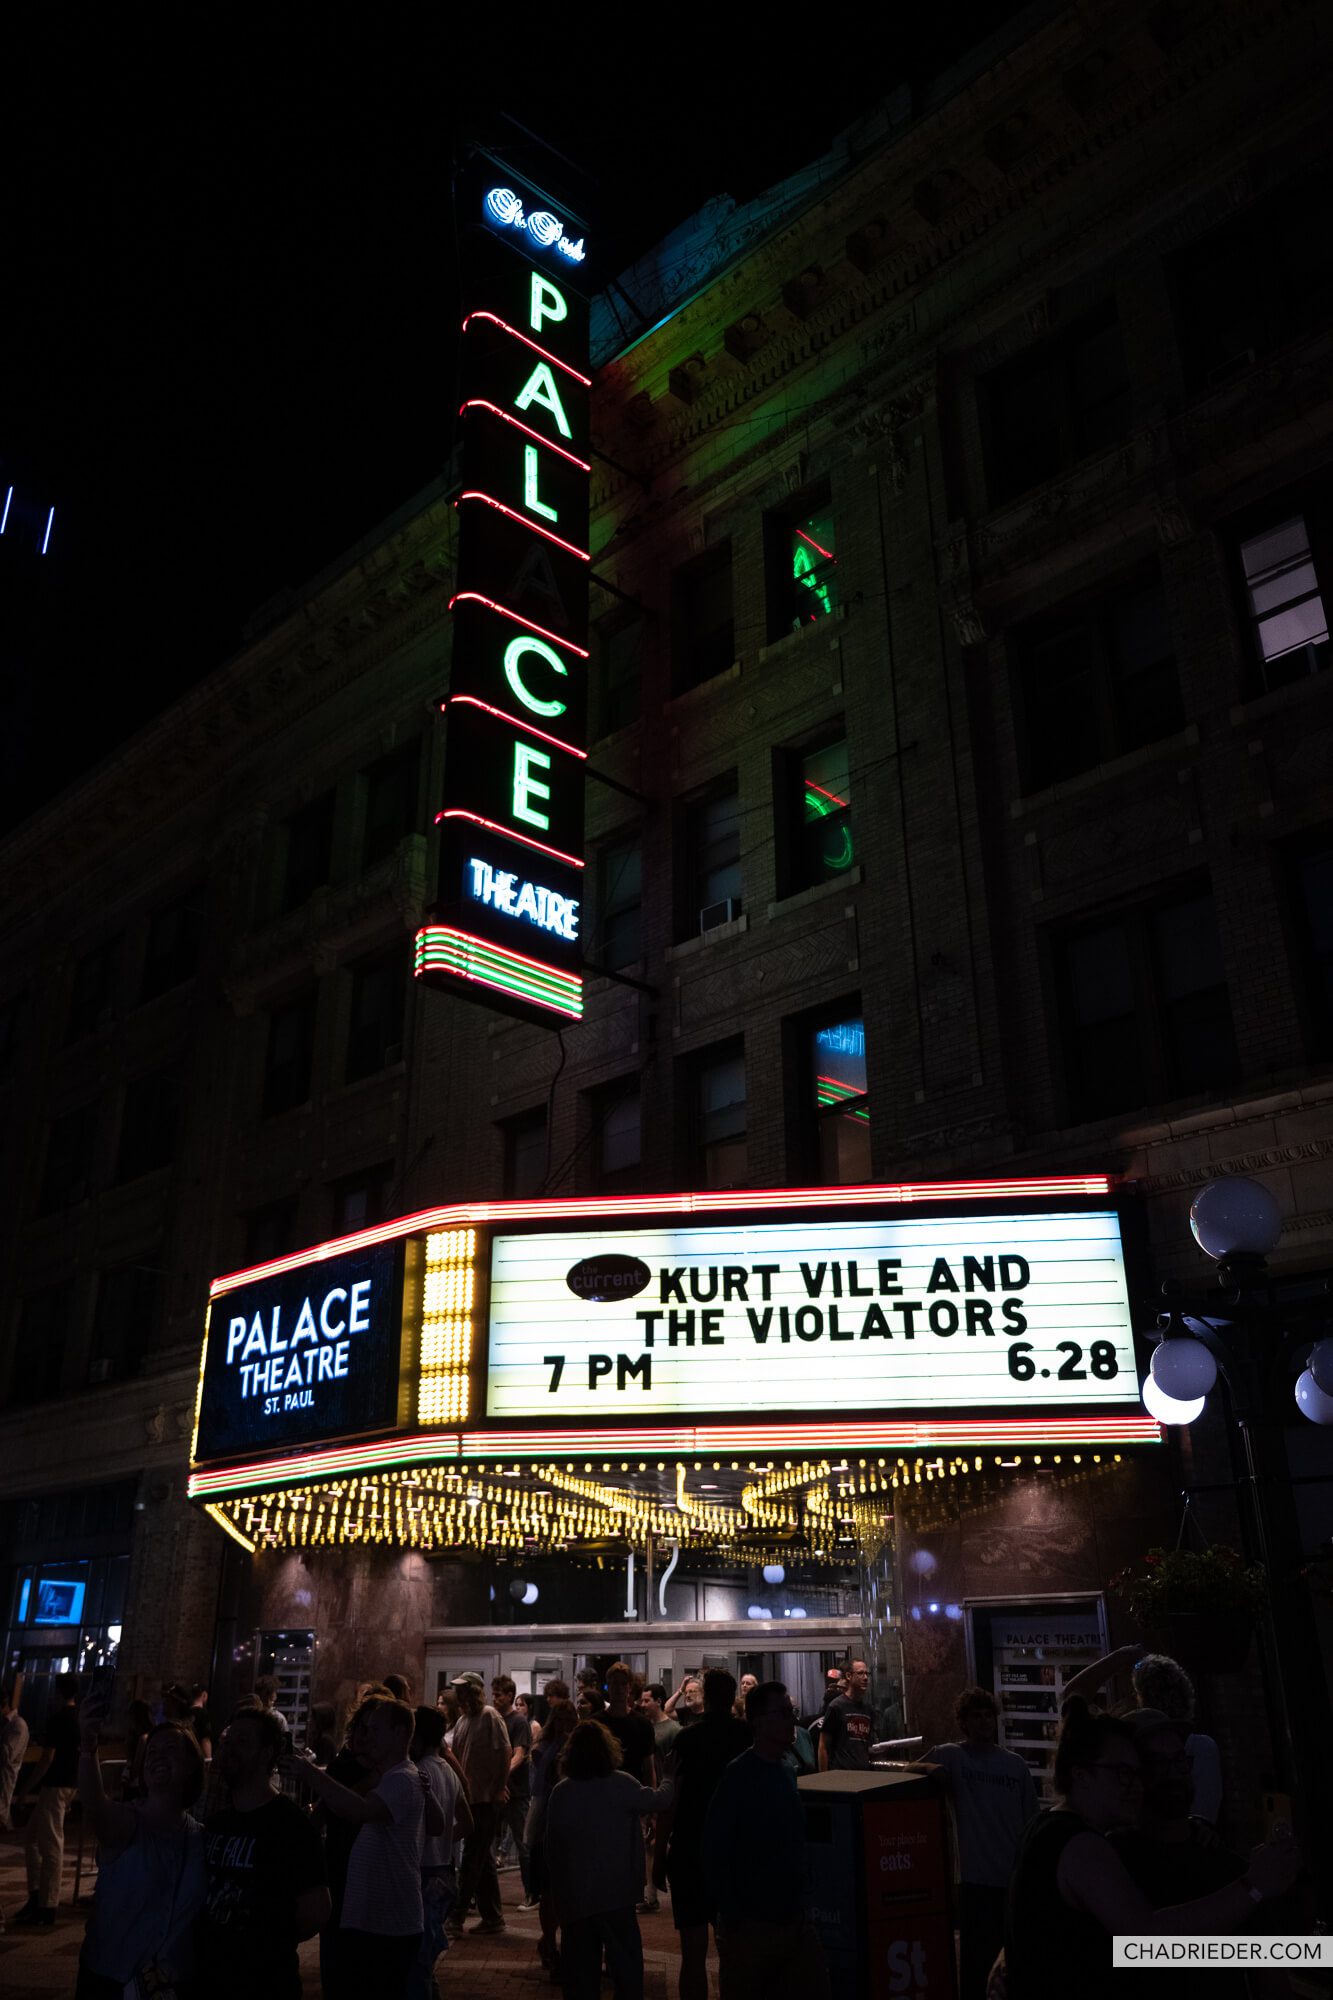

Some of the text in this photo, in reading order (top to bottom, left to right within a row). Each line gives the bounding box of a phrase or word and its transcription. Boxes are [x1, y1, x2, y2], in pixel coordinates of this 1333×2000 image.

[504, 271, 572, 832] PALACE
[470, 857, 580, 941] THEATRE
[572, 1269, 643, 1290] current
[581, 1265, 599, 1275] the
[660, 1254, 1030, 1304] KURT VILE AND
[226, 1279, 372, 1365] PALACE
[636, 1297, 1028, 1348] THE VIOLATORS
[239, 1340, 351, 1399] THEATRE
[543, 1353, 652, 1393] 7 PM
[1007, 1340, 1119, 1382] 6.28
[264, 1389, 316, 1416] ST. PAUL
[1006, 1633, 1101, 1645] PALACE THEATR
[221, 1835, 256, 1869] FALL
[888, 1939, 929, 1993] St
